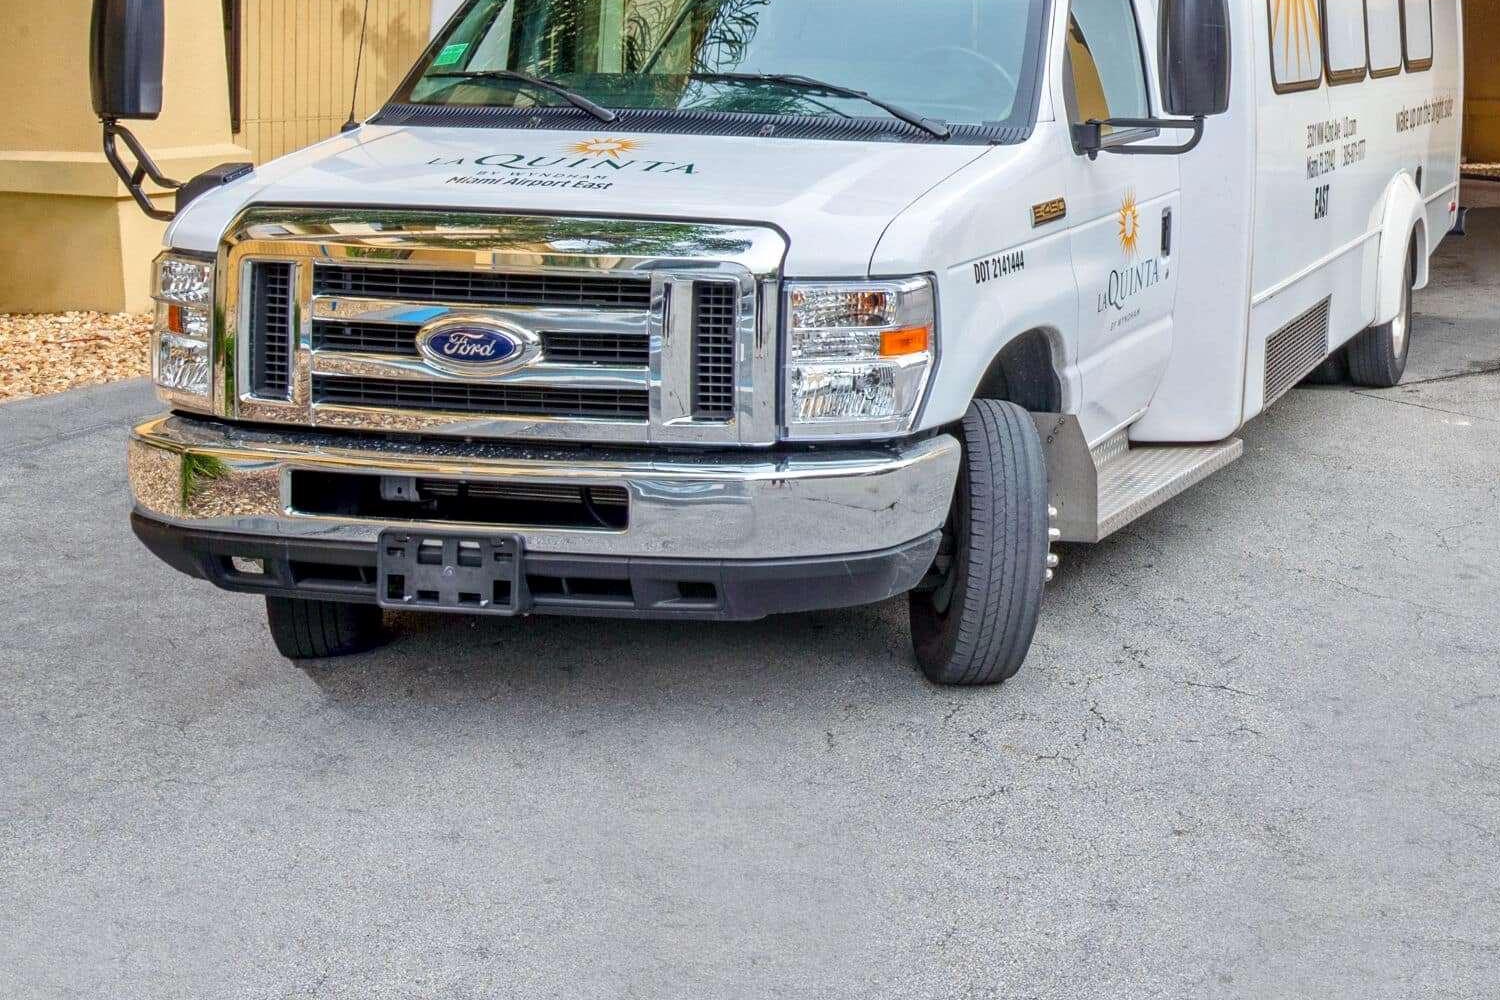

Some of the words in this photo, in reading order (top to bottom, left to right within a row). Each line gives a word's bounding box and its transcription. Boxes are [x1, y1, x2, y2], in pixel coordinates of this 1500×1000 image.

[426, 157, 465, 165] LA
[474, 153, 696, 175] QUINTA
[509, 172, 608, 180] WYNDHAM
[446, 176, 502, 185] Miami
[503, 178, 572, 189] Airport
[573, 180, 614, 190] East
[1314, 184, 1329, 219] EAST
[973, 259, 991, 285] DOT
[992, 250, 1025, 279] 2141444
[1097, 292, 1108, 313] LA
[1107, 258, 1160, 311] QUINTA
[444, 332, 496, 356] Ford
